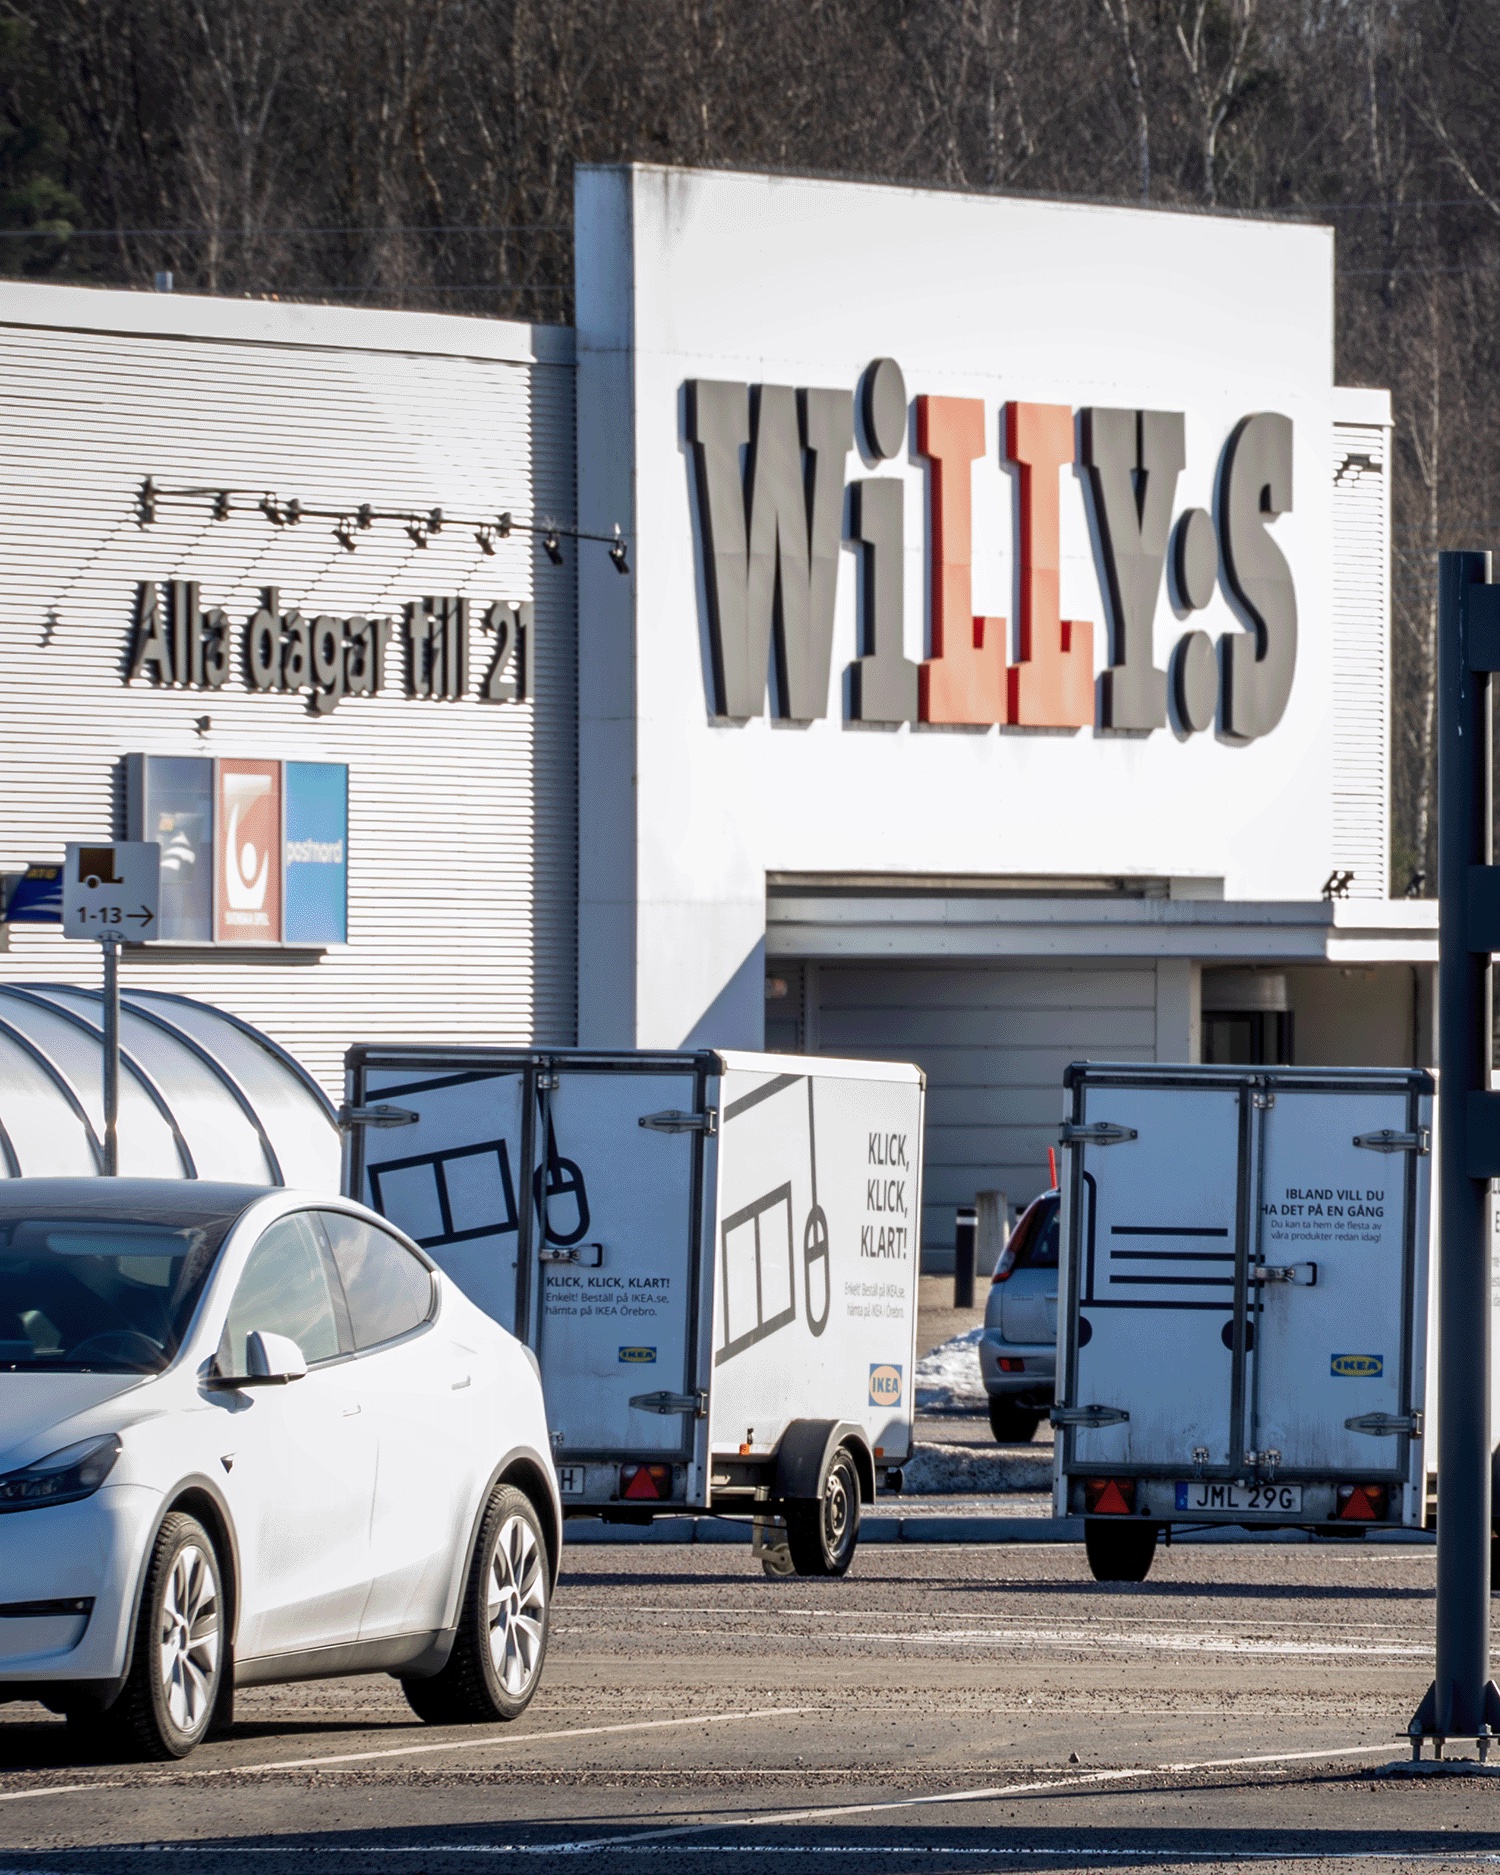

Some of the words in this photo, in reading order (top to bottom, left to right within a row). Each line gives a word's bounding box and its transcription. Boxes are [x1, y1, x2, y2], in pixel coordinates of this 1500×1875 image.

[130, 581, 228, 687] Alla
[249, 587, 391, 715] dagar
[409, 597, 470, 697] till
[486, 600, 534, 700] 21
[286, 839, 343, 864] postnord
[77, 906, 122, 924] 1-13
[868, 1132, 909, 1172] KLICK,
[867, 1179, 908, 1218] KLICK,
[1286, 1188, 1333, 1200] IBLAND
[1337, 1189, 1362, 1200] VILL
[1366, 1190, 1384, 1201] DU
[1261, 1204, 1277, 1215] HA
[1281, 1204, 1304, 1216] DET
[1308, 1203, 1324, 1216] PÅ
[1327, 1205, 1343, 1216] EN
[1347, 1204, 1384, 1217] GÅNG
[1271, 1220, 1283, 1229] Du
[1285, 1220, 1300, 1229] kan
[1302, 1221, 1311, 1229] ta
[1313, 1221, 1332, 1229] hem
[1334, 1221, 1345, 1230] de
[1347, 1221, 1370, 1230] flesta
[1372, 1222, 1382, 1230] av
[860, 1225, 907, 1260] KLART!
[1271, 1230, 1289, 1240] våra
[1291, 1231, 1332, 1242] produkter
[1335, 1232, 1359, 1241] redan
[1361, 1232, 1381, 1244] idag!
[546, 1277, 584, 1289] KLICK,
[588, 1277, 625, 1289] KLICK,
[628, 1278, 670, 1288] KLART!
[545, 1292, 579, 1303] Enkelt!
[581, 1292, 614, 1303] Beställ
[616, 1293, 628, 1304] på
[631, 1294, 670, 1304] IKEA.se,
[545, 1305, 577, 1315] hämta
[580, 1305, 592, 1317] på
[595, 1306, 617, 1316] IKEA
[620, 1305, 657, 1316] Örebro.
[622, 1350, 654, 1359] IKEA
[1336, 1360, 1378, 1370] IKEA
[872, 1376, 899, 1394] IKEA
[1197, 1485, 1239, 1507] JML
[1248, 1486, 1293, 1509] 29G
